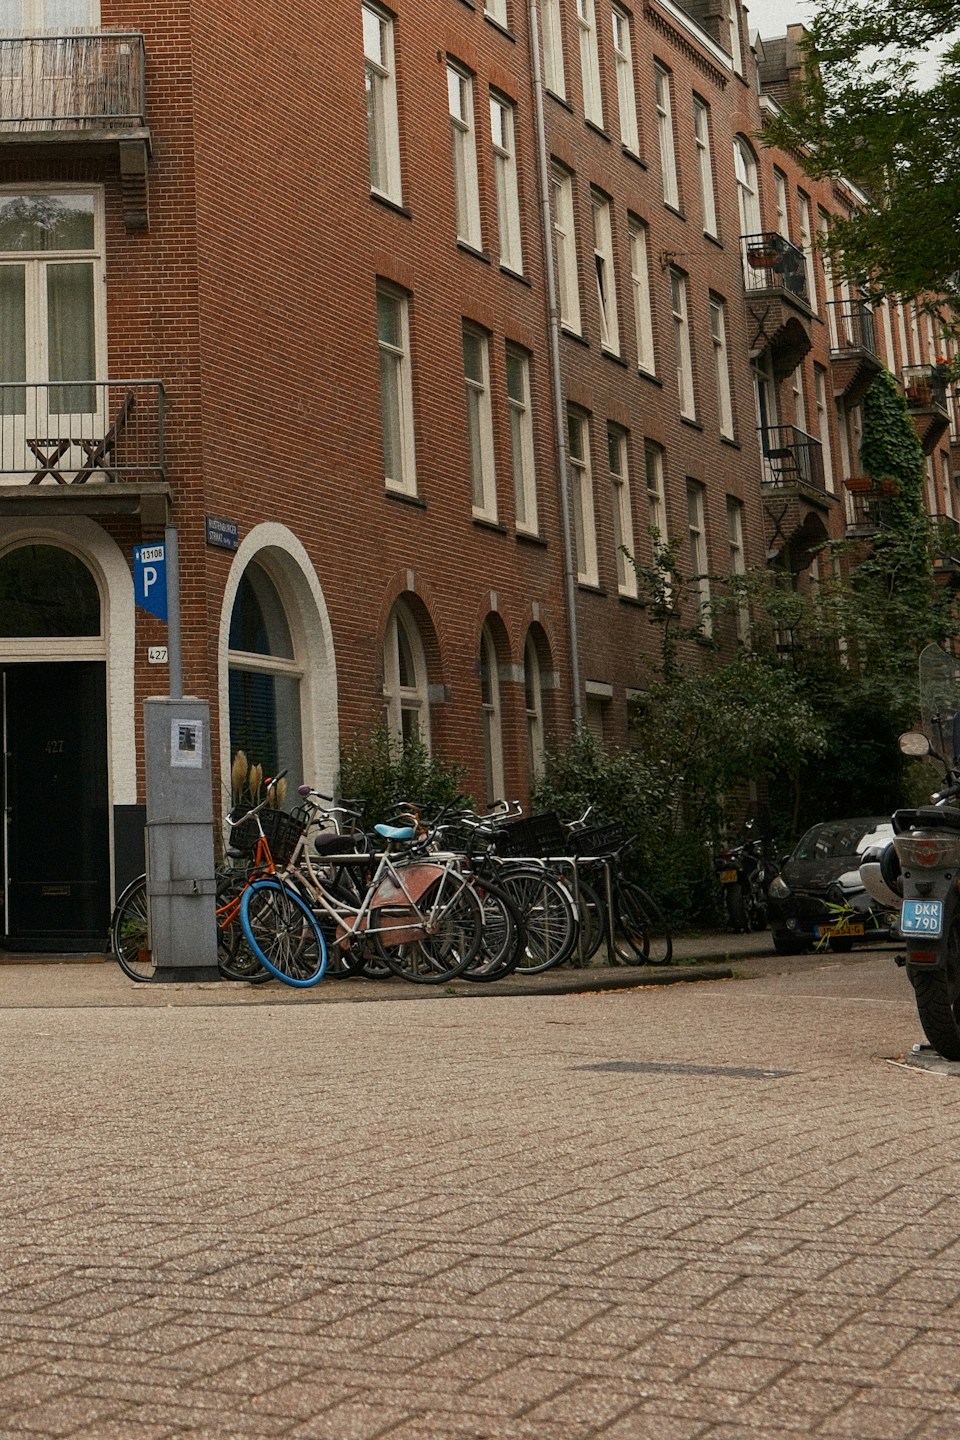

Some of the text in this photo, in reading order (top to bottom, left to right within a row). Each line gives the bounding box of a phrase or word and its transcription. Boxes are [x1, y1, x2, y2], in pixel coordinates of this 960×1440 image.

[142, 549, 163, 560] 13108
[143, 566, 158, 597] P
[149, 650, 167, 660] 427
[45, 740, 64, 753] 427
[915, 903, 939, 916] DKR
[915, 916, 938, 930] 79D
